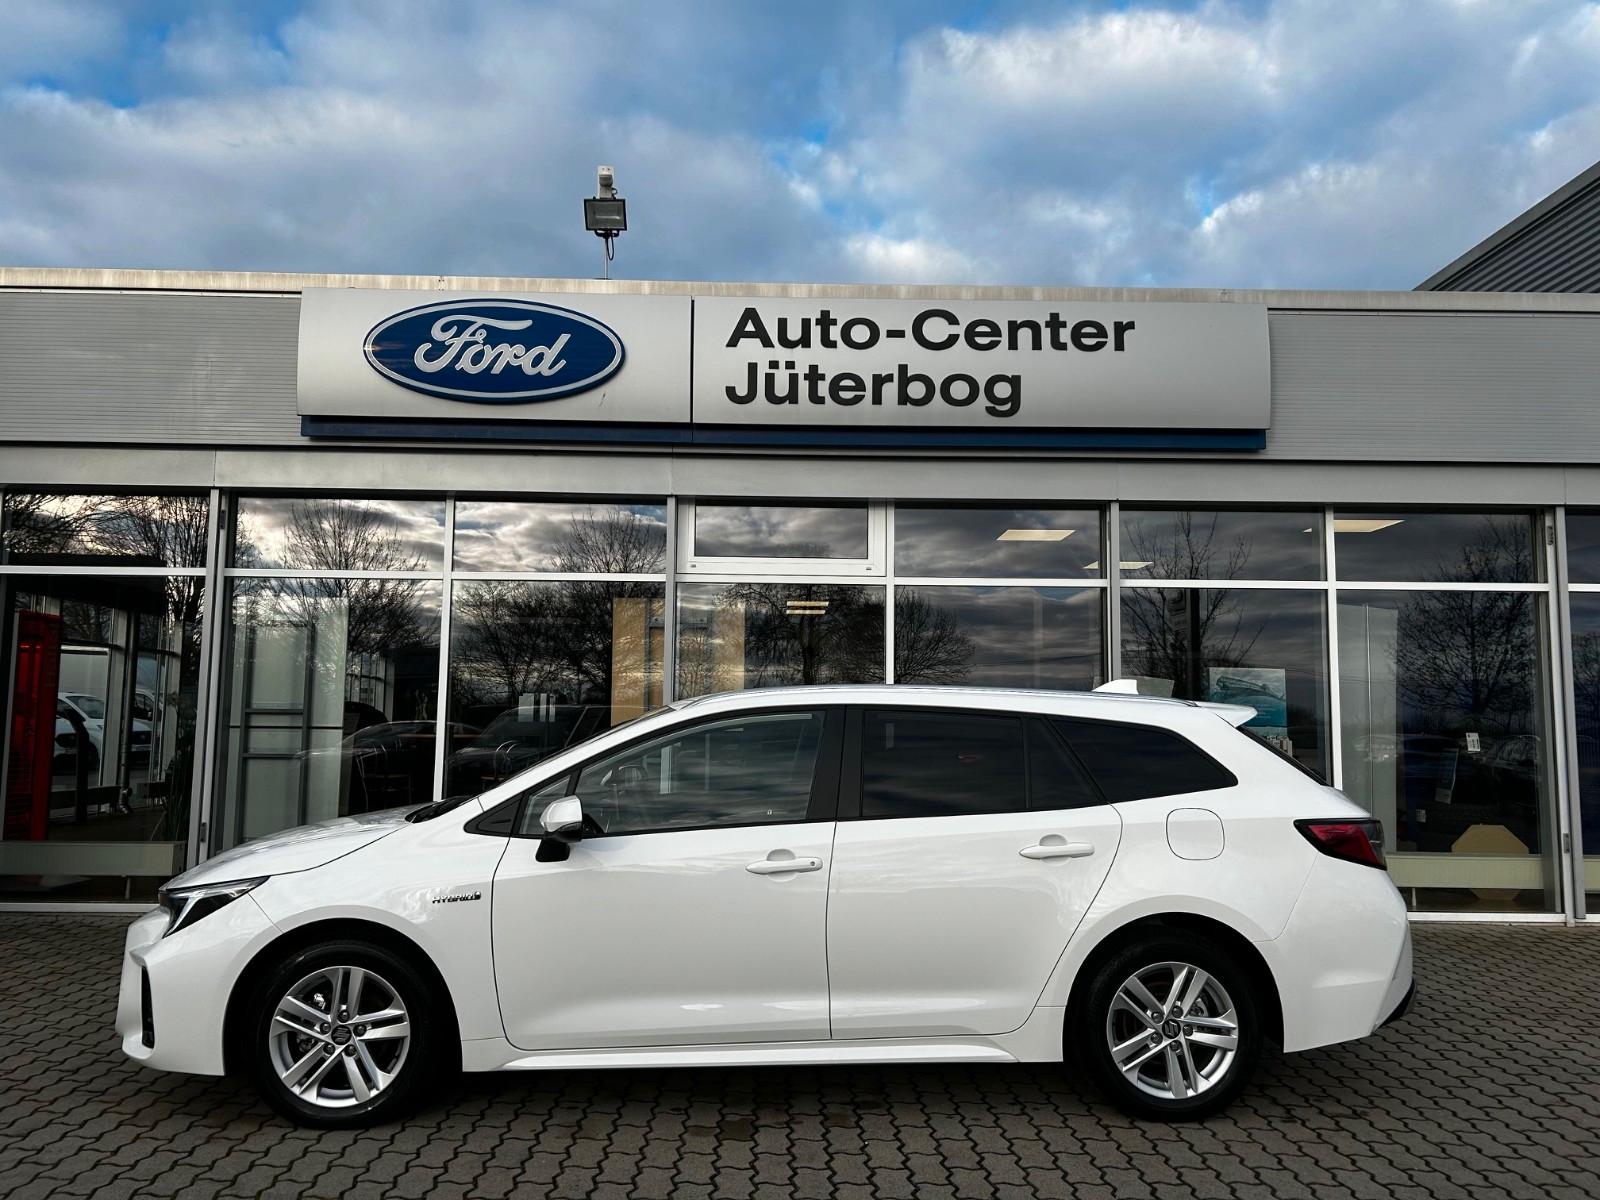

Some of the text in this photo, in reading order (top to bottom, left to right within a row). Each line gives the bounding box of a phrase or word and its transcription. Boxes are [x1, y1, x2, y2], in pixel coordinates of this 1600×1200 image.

[414, 314, 571, 377] Ford
[725, 307, 1136, 352] Auto-Center
[725, 360, 1022, 418] Jüterbog
